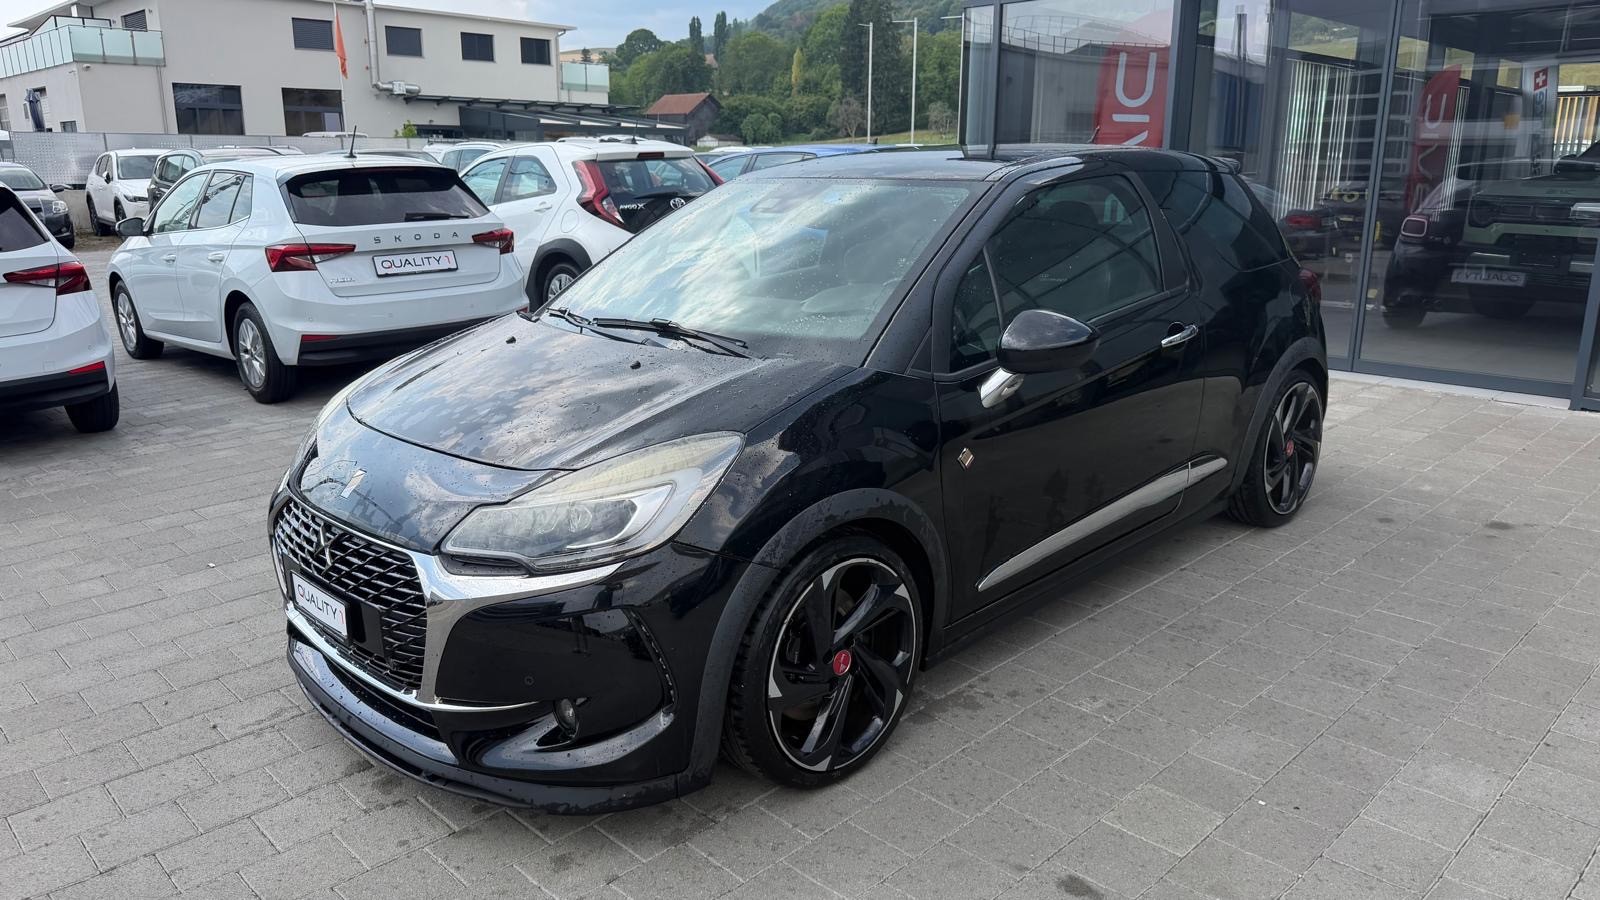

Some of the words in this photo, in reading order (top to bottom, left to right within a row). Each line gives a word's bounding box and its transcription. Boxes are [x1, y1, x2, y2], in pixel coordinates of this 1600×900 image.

[381, 255, 442, 270] QUALITY
[444, 255, 451, 265] 1
[298, 584, 337, 620] QUALITY
